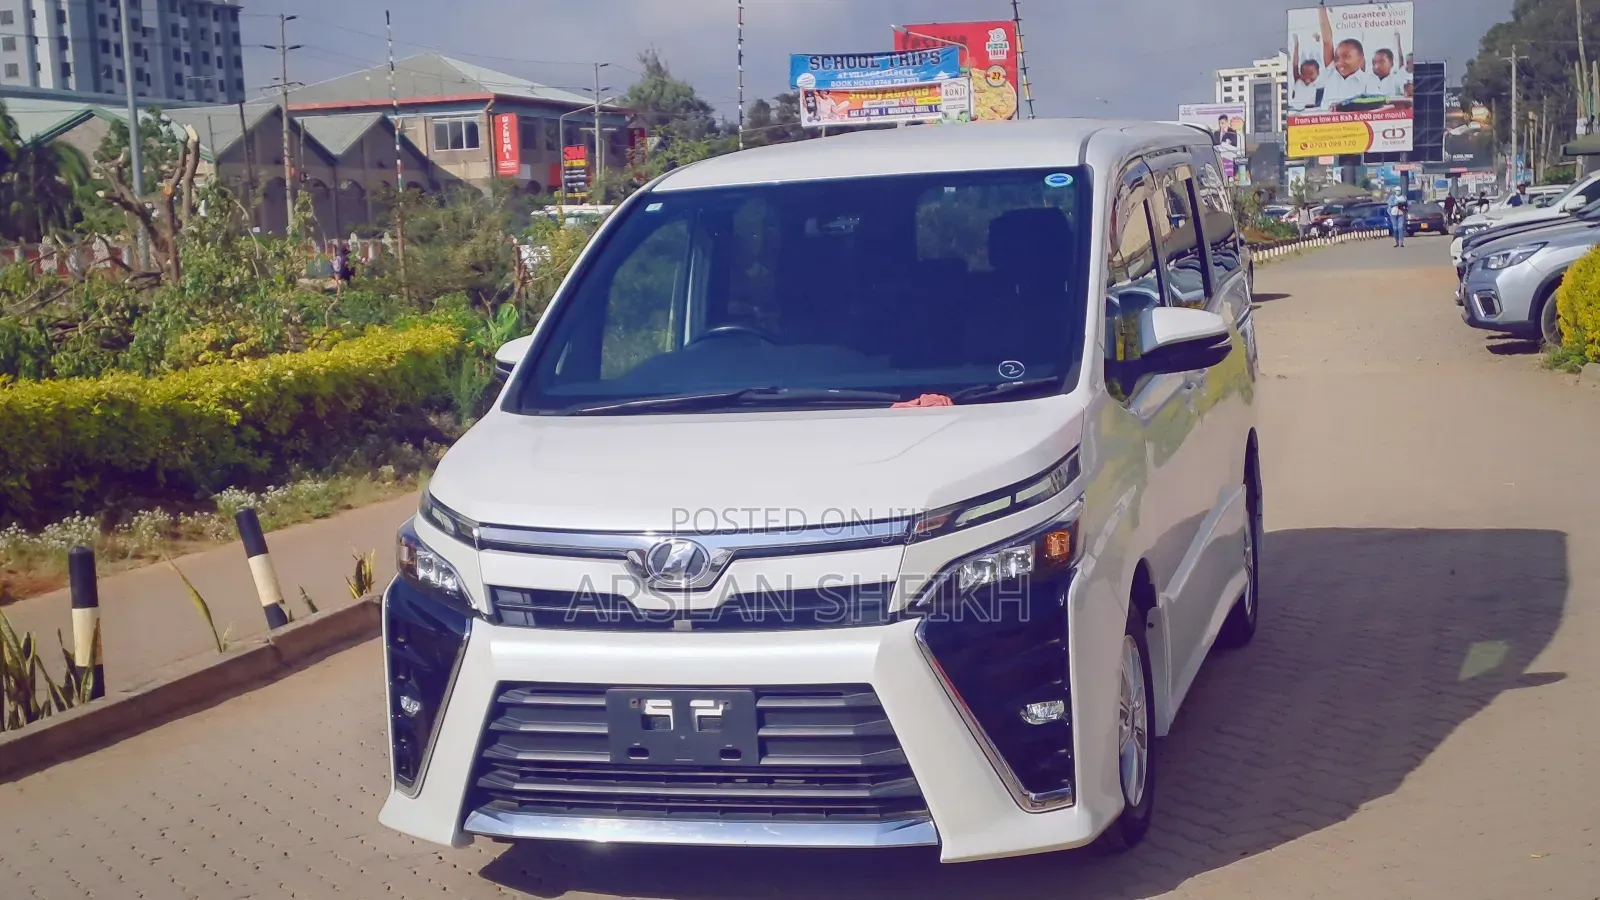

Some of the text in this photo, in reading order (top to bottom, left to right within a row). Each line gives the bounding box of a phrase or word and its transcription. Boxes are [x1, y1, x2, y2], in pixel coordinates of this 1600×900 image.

[1342, 10, 1406, 20] Guarantee your
[1336, 18, 1407, 29] Child's Education
[809, 51, 941, 71] SCHOOL TRIPS
[881, 69, 914, 78] MARKET
[1373, 113, 1384, 121] per
[1384, 111, 1407, 119] month
